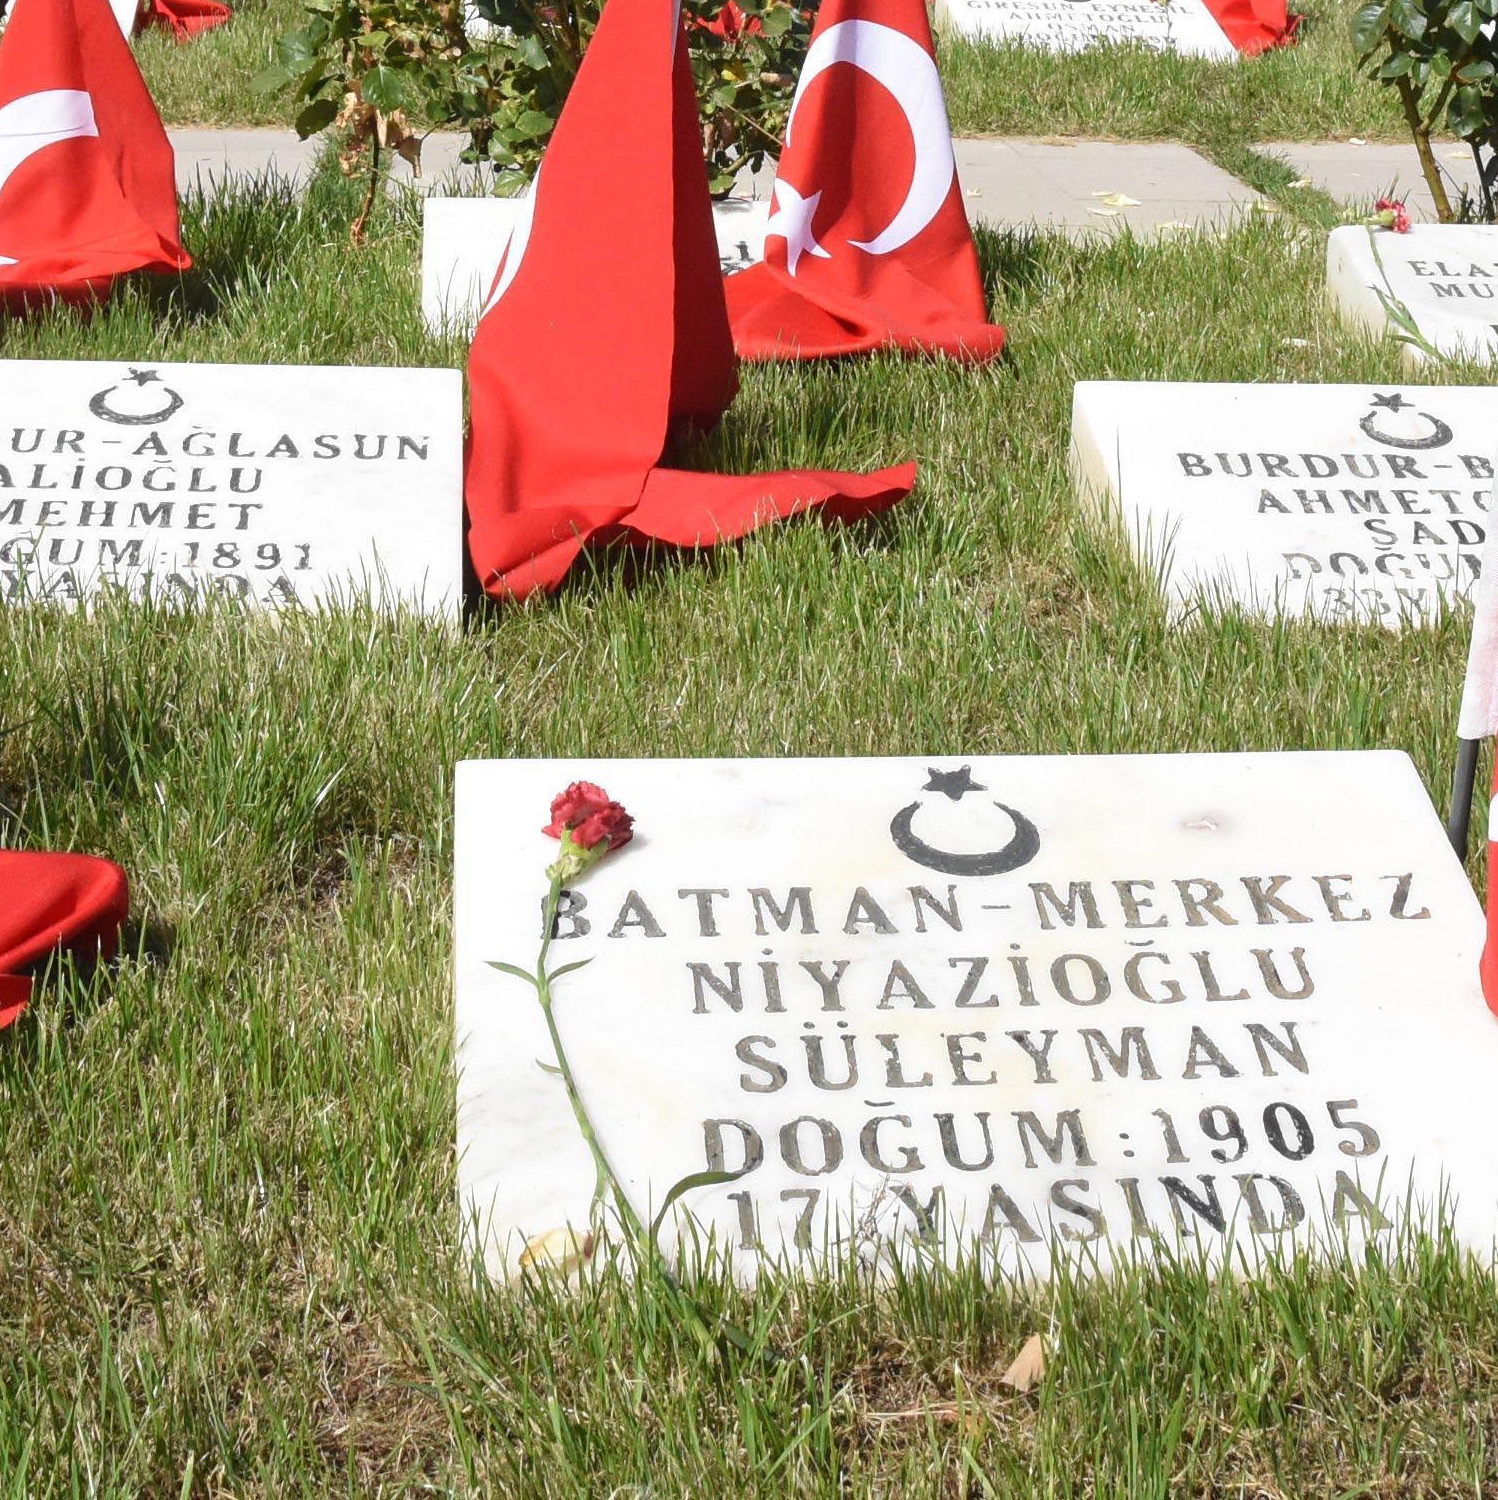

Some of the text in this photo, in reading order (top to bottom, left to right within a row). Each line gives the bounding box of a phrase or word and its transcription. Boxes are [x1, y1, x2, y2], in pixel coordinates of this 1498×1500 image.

[1176, 452, 1495, 479] BURDUR-B
[1257, 487, 1493, 515] AHMETO
[1361, 518, 1487, 546] SAD
[683, 940, 1319, 1015] NİYAZİOĞLU
[733, 1019, 1311, 1095] SÜLEYMAN
